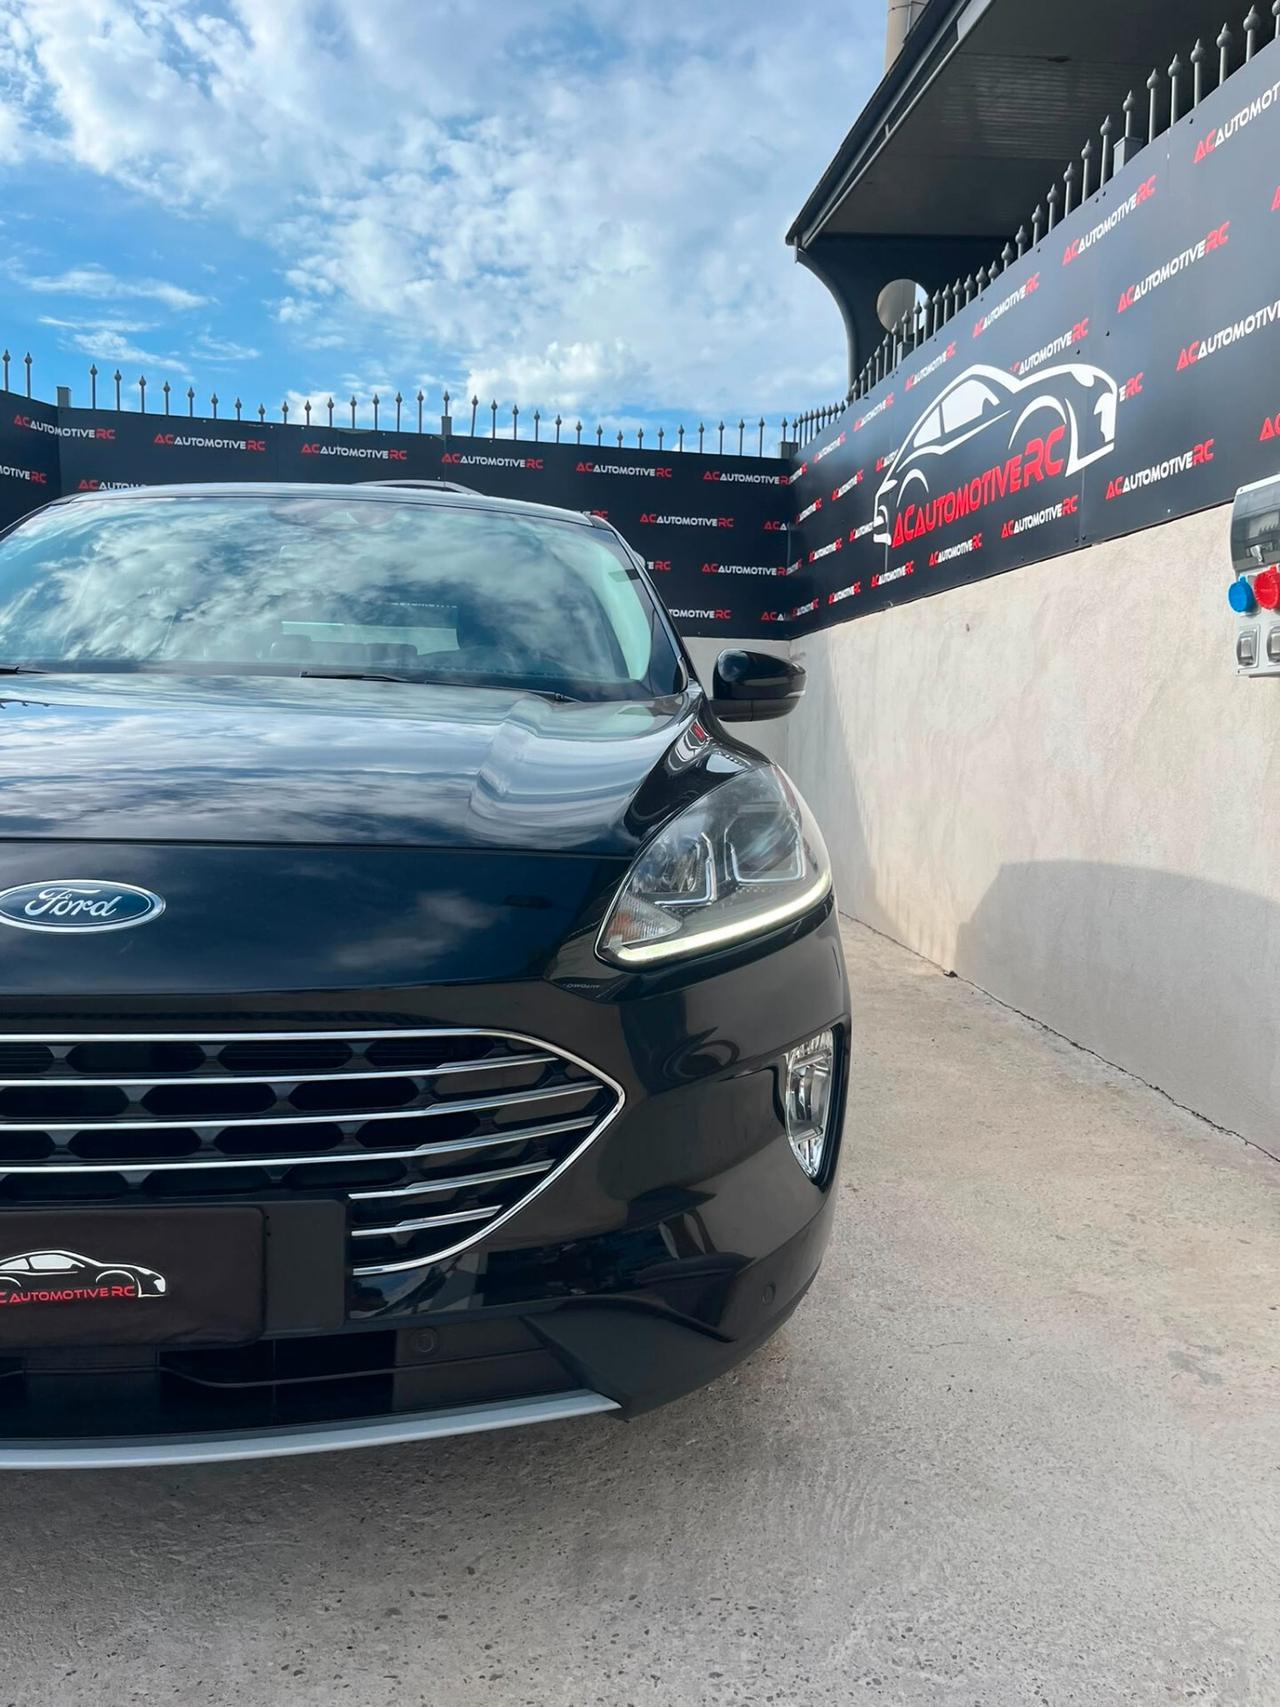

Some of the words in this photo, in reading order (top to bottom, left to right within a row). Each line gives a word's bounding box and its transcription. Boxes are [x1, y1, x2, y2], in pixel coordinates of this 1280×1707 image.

[1118, 221, 1231, 313] ACAUTOMOTIVERC
[14, 414, 116, 439] ACAUTOMOTIVERC
[154, 433, 265, 452] ACAUTOMOTIVERC
[301, 443, 407, 460] ACAUTOMOTIVERC
[442, 453, 544, 470] ACAUTOMOTIVERC
[576, 462, 672, 478] ACAUTOMOTIVERC
[1106, 438, 1214, 499] ACAUTOMOTIVERC
[891, 424, 1066, 548] ACAUTOMOTIVERC
[640, 513, 734, 528] ACAUTOMOTIVERC
[25, 888, 118, 918] Ford
